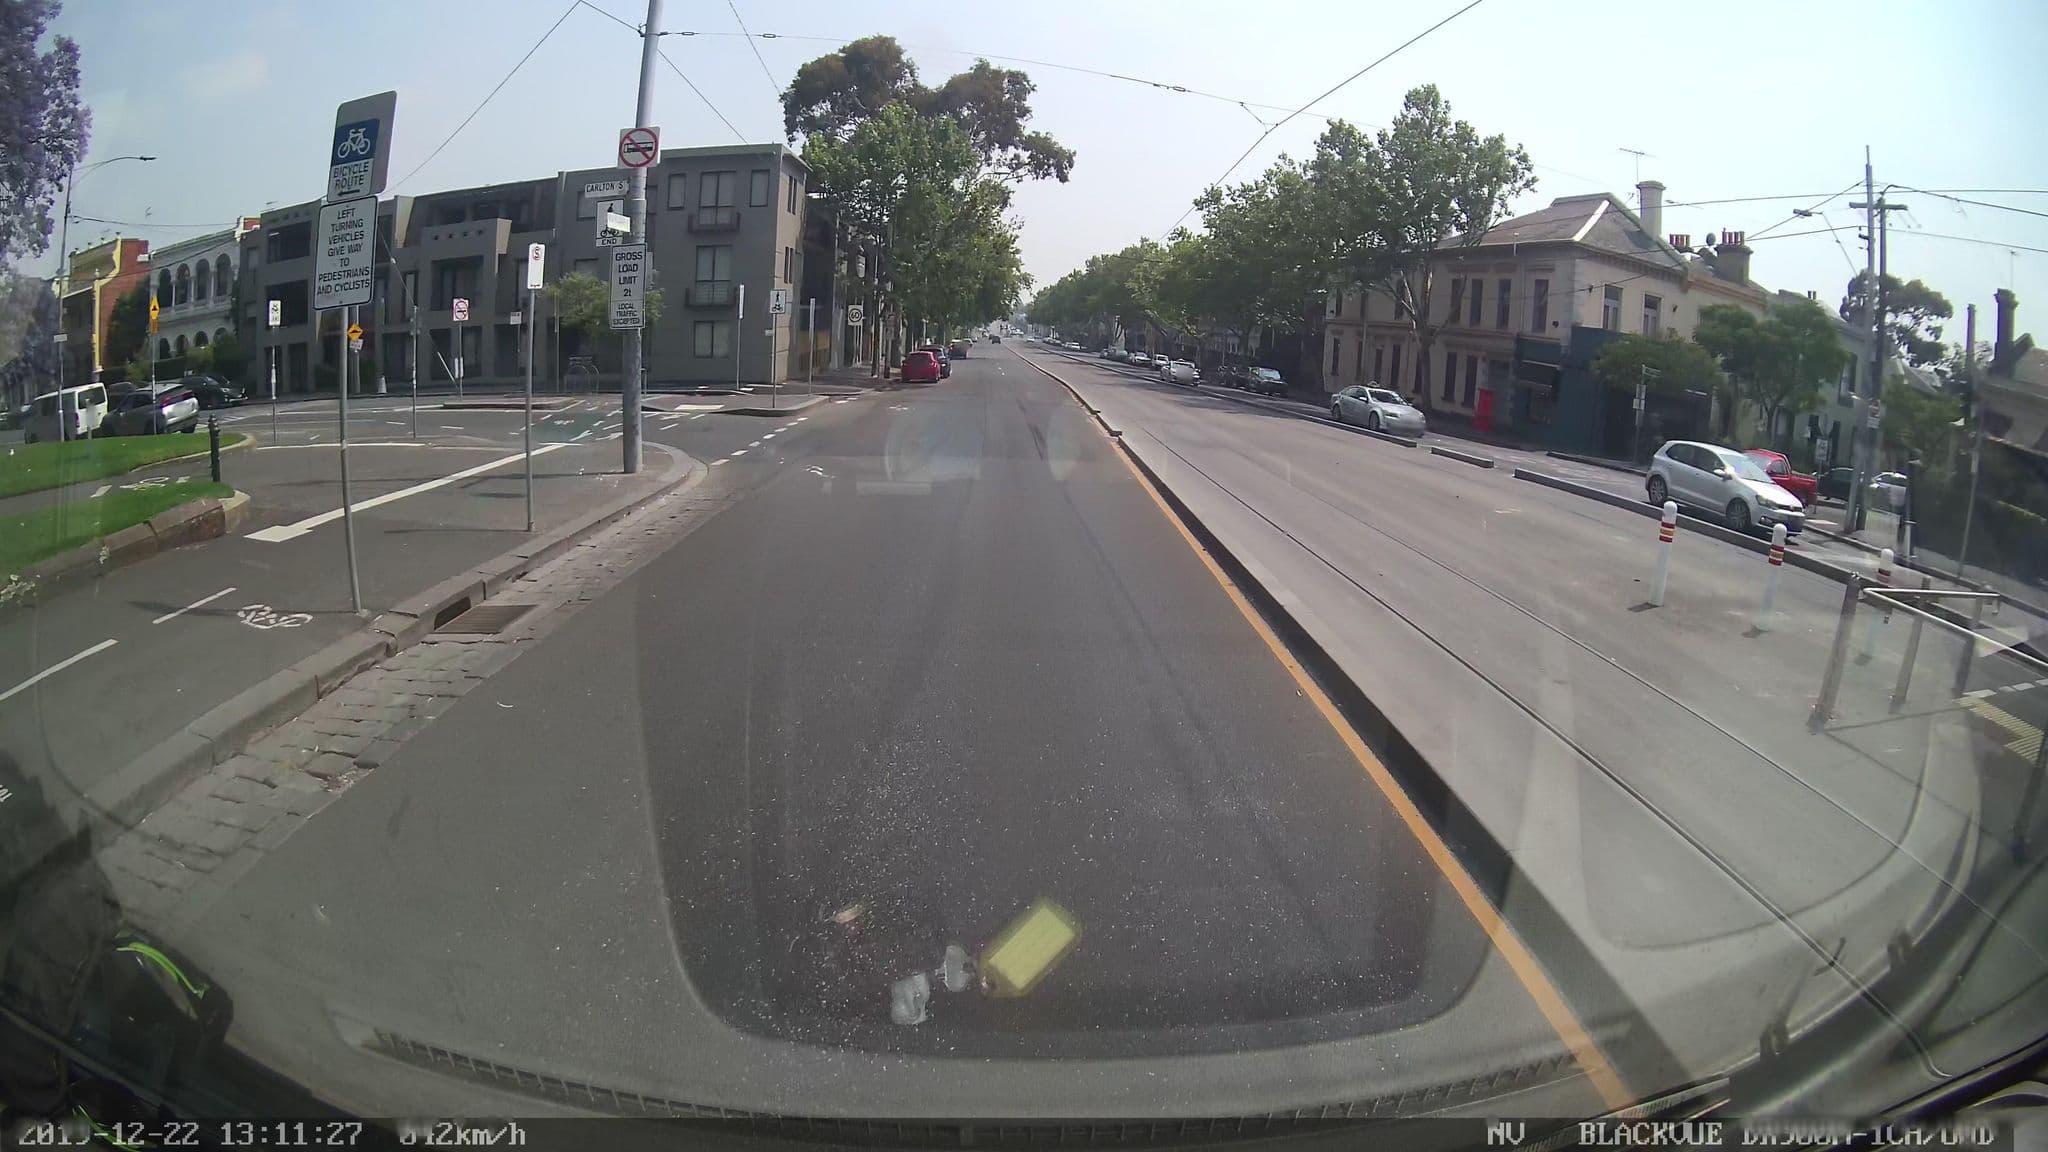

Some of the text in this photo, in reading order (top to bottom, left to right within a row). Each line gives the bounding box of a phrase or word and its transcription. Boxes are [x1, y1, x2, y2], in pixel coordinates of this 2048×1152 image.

[333, 161, 369, 178] BICYCLE
[334, 175, 364, 190] ROUTE
[586, 182, 615, 192] CARLTON
[337, 208, 356, 219] LEFT
[331, 219, 363, 232] TURNING
[328, 231, 364, 245] VEHICLES
[601, 238, 617, 246] END
[327, 242, 363, 257] GIVE WAY
[615, 252, 643, 261] GROSS
[340, 257, 350, 267] TO
[618, 264, 639, 273] LOAD
[318, 266, 370, 282] PEDESTRIANS
[618, 276, 638, 284] LIMIT
[316, 279, 370, 296] AND CYCLISTS
[623, 288, 632, 297] 2t
[616, 310, 638, 318] TRAFFIC
[851, 311, 860, 319] 60
